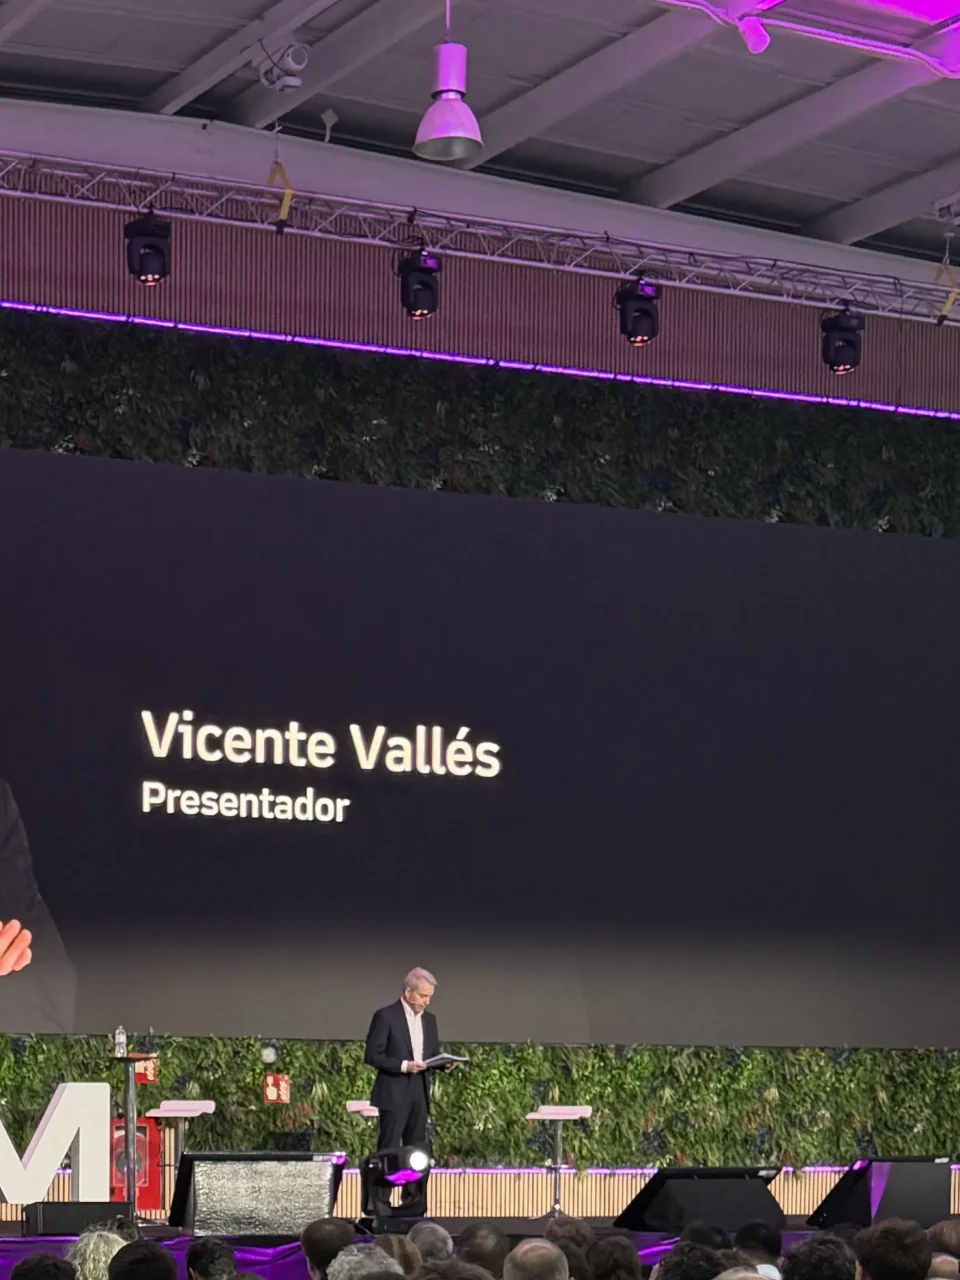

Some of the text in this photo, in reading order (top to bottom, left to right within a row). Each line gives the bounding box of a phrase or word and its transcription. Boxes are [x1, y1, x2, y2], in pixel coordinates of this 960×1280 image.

[141, 710, 501, 778] Vicente Vallés
[142, 781, 350, 823] Presentador
